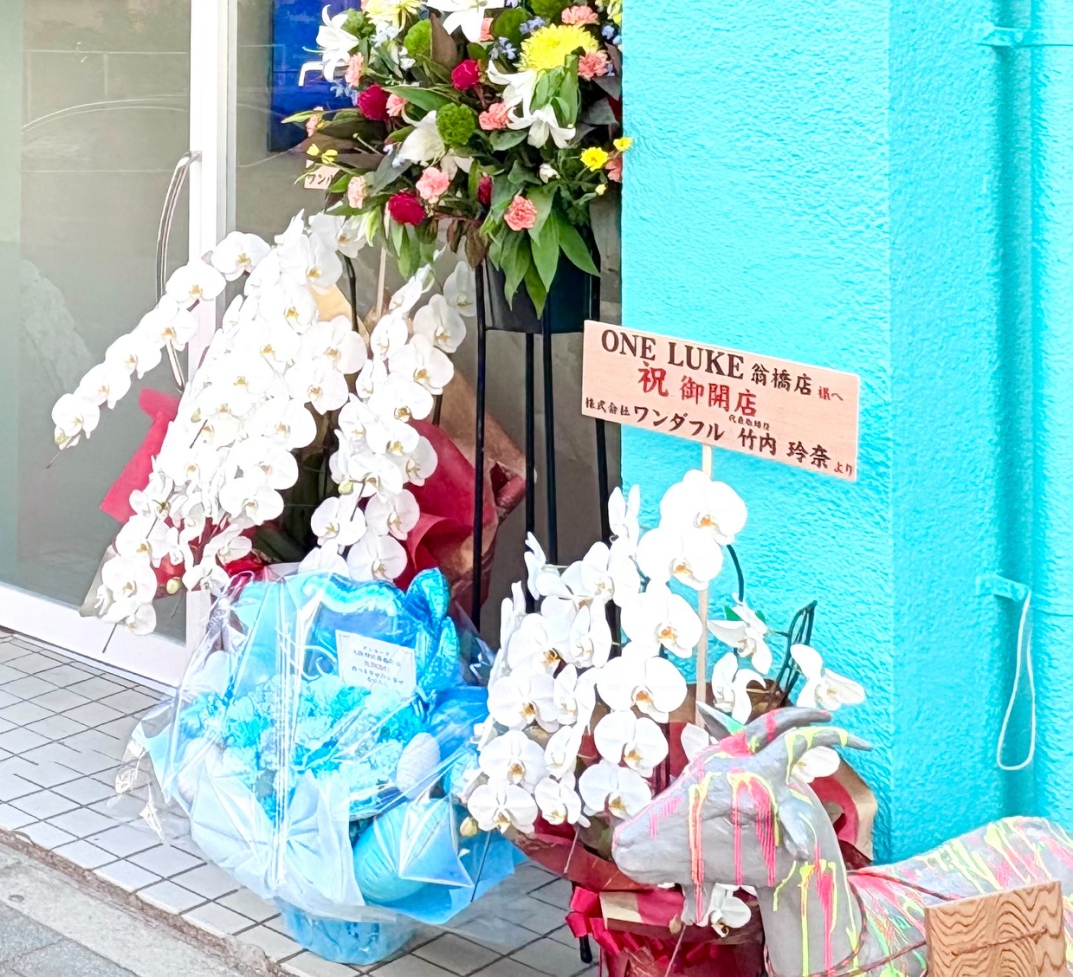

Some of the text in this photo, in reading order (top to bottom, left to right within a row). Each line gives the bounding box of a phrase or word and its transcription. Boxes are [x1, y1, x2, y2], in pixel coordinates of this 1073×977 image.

[601, 330, 656, 361] ONE
[668, 341, 744, 380] LUKE
[751, 363, 813, 396] 翁橋店
[638, 361, 757, 417] 祝 御開店
[737, 427, 777, 456] 竹内
[786, 441, 832, 469] 玲奈
